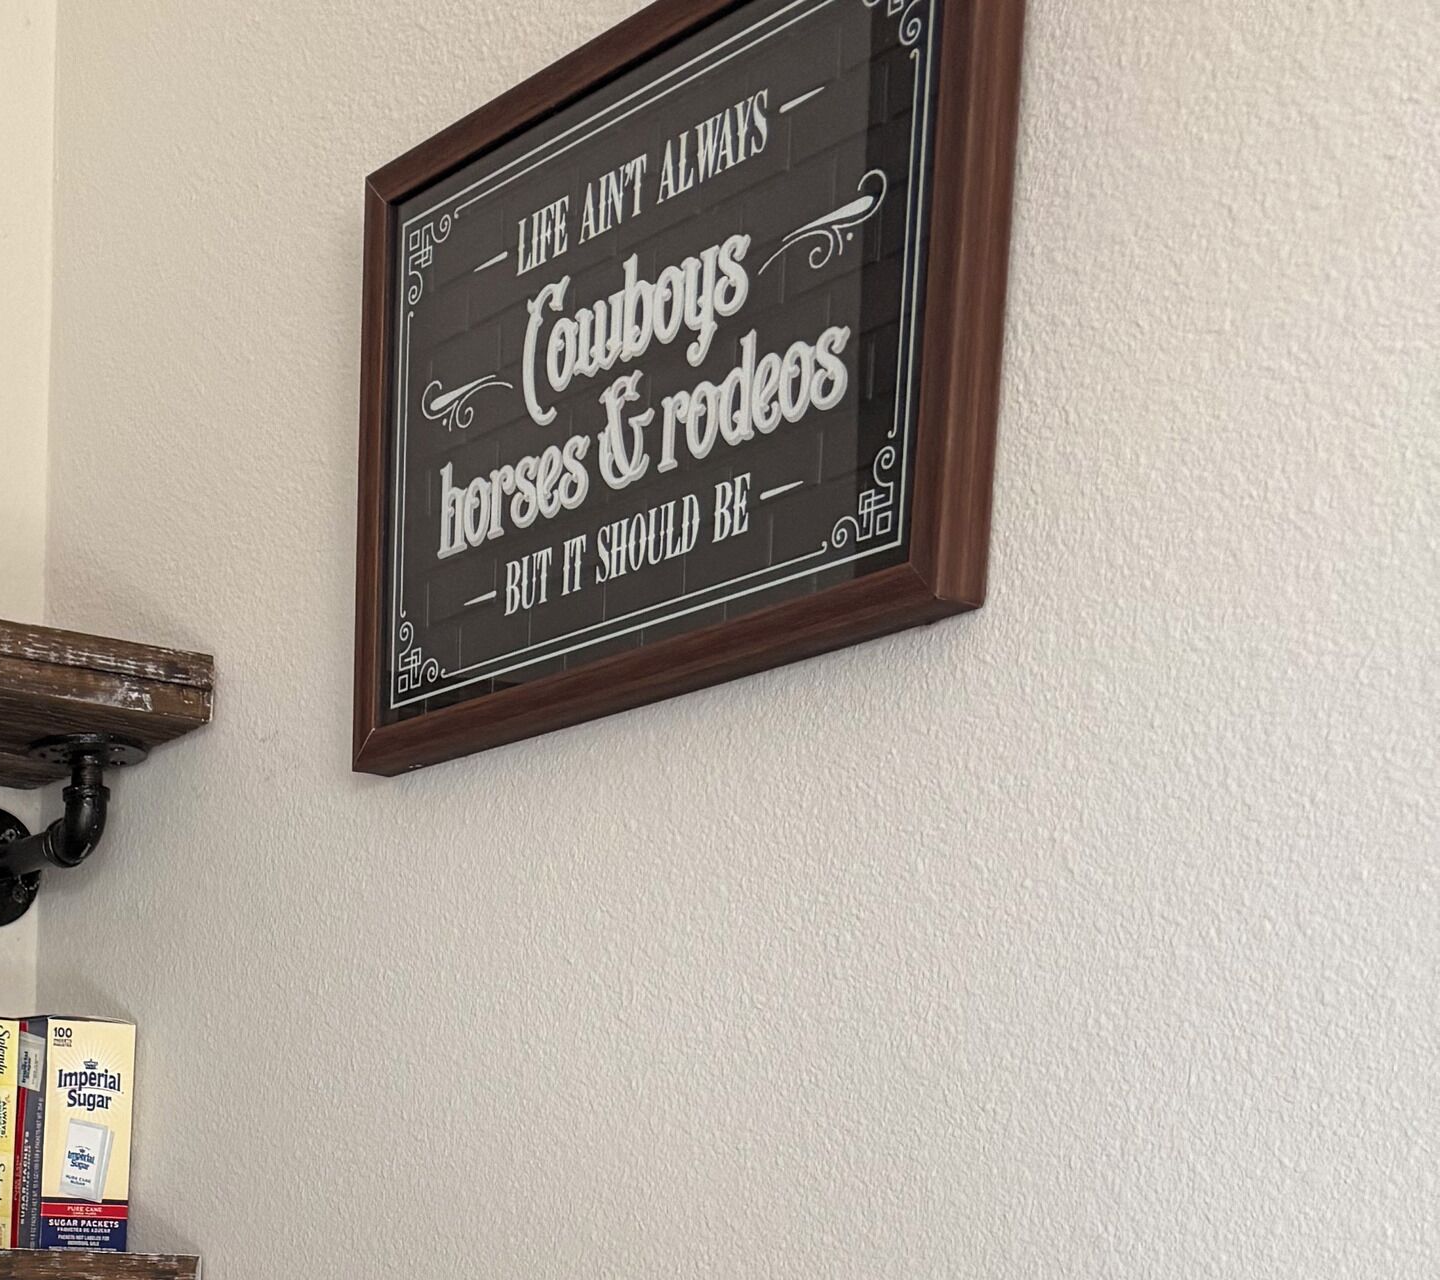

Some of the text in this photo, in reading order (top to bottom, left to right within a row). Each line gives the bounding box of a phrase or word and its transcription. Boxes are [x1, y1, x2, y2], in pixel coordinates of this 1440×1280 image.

[516, 88, 769, 277] LIFE AIN'T ALWAYS
[522, 234, 751, 427] Cowboys
[437, 325, 852, 559] horses & rodeos
[503, 472, 753, 617] BUT IT SHOULD BE
[53, 1026, 72, 1038] 100
[57, 1068, 121, 1091] Imperial
[67, 1089, 112, 1111] Sugar
[67, 1150, 95, 1165] Imperial
[70, 1161, 90, 1170] Sugar
[80, 1219, 119, 1228] PACKETS
